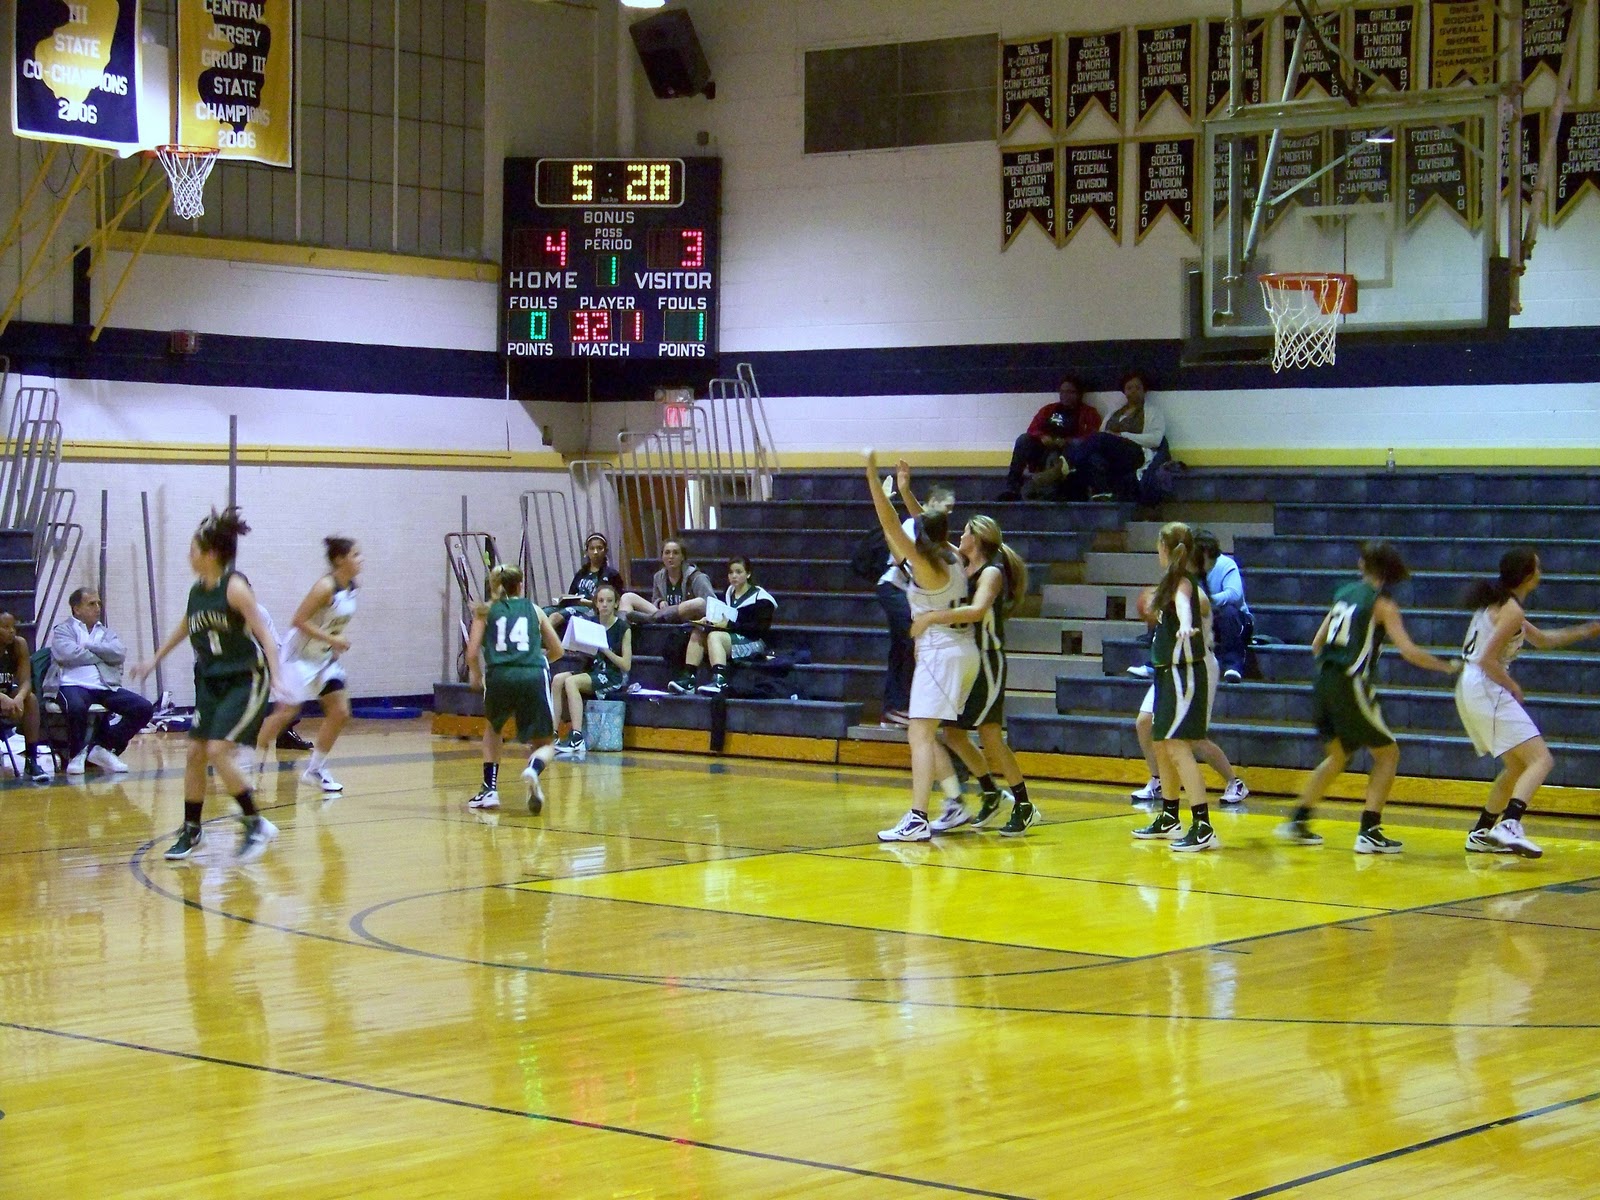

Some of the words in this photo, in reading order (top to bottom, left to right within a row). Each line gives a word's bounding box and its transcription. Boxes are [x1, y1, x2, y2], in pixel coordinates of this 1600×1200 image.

[203, 0, 265, 22] CENTRAL
[1380, 20, 1412, 33] HOCKEY
[1439, 25, 1488, 36] OVERALL
[208, 23, 261, 47] JERSEY
[1154, 29, 1176, 40] BOYS
[54, 39, 100, 59] STATE
[1078, 47, 1110, 60] SOCCER
[1364, 45, 1402, 58] DIVISION
[201, 49, 247, 70] GROUP
[1147, 62, 1182, 75] DIVISION
[1077, 70, 1110, 83] DIVISION
[1141, 73, 1187, 88] CHAMPIONS
[213, 76, 257, 99] STATE
[1005, 87, 1049, 101] CHAMPIONS
[1071, 80, 1115, 94] CHAMPIONS
[58, 100, 98, 124] 2006
[195, 101, 271, 126] CHAMPIONS
[217, 130, 257, 149] 2006
[1071, 149, 1112, 161] FOOTBALL
[1155, 143, 1178, 154] GIRLS
[1414, 143, 1457, 156] FEDERAL
[1150, 154, 1182, 166] SOCCER
[1417, 156, 1455, 170] DIVISION
[1073, 164, 1109, 175] FEDERAL
[1076, 178, 1108, 190] DIVISION
[1150, 177, 1183, 189] DIVISION
[1411, 170, 1461, 185] CHAMPIONS
[1013, 185, 1044, 198] DIVISION
[1339, 180, 1387, 194] CHAMPIONS
[1069, 191, 1114, 205] CHAMPIONS
[1144, 188, 1188, 201] CHAMPIONS
[1008, 197, 1050, 210] CHAMPIONS
[583, 211, 635, 224] BONUS
[595, 228, 623, 238] POSS
[546, 231, 567, 267] 4
[584, 239, 632, 250] PERIOD
[681, 231, 703, 267] 3
[611, 256, 617, 285] 1
[509, 271, 578, 289] HOME
[634, 272, 712, 290] VISITOR
[509, 297, 558, 309] FOULS
[579, 297, 636, 310] PLAYER
[658, 297, 707, 310] FOULS
[530, 311, 547, 340] 0
[572, 312, 609, 341] 32
[635, 312, 641, 341] 1
[698, 312, 704, 341] 1
[507, 343, 553, 356] POINTS
[658, 343, 706, 357] POINTS
[495, 616, 530, 651] 14
[207, 629, 223, 656] 1
